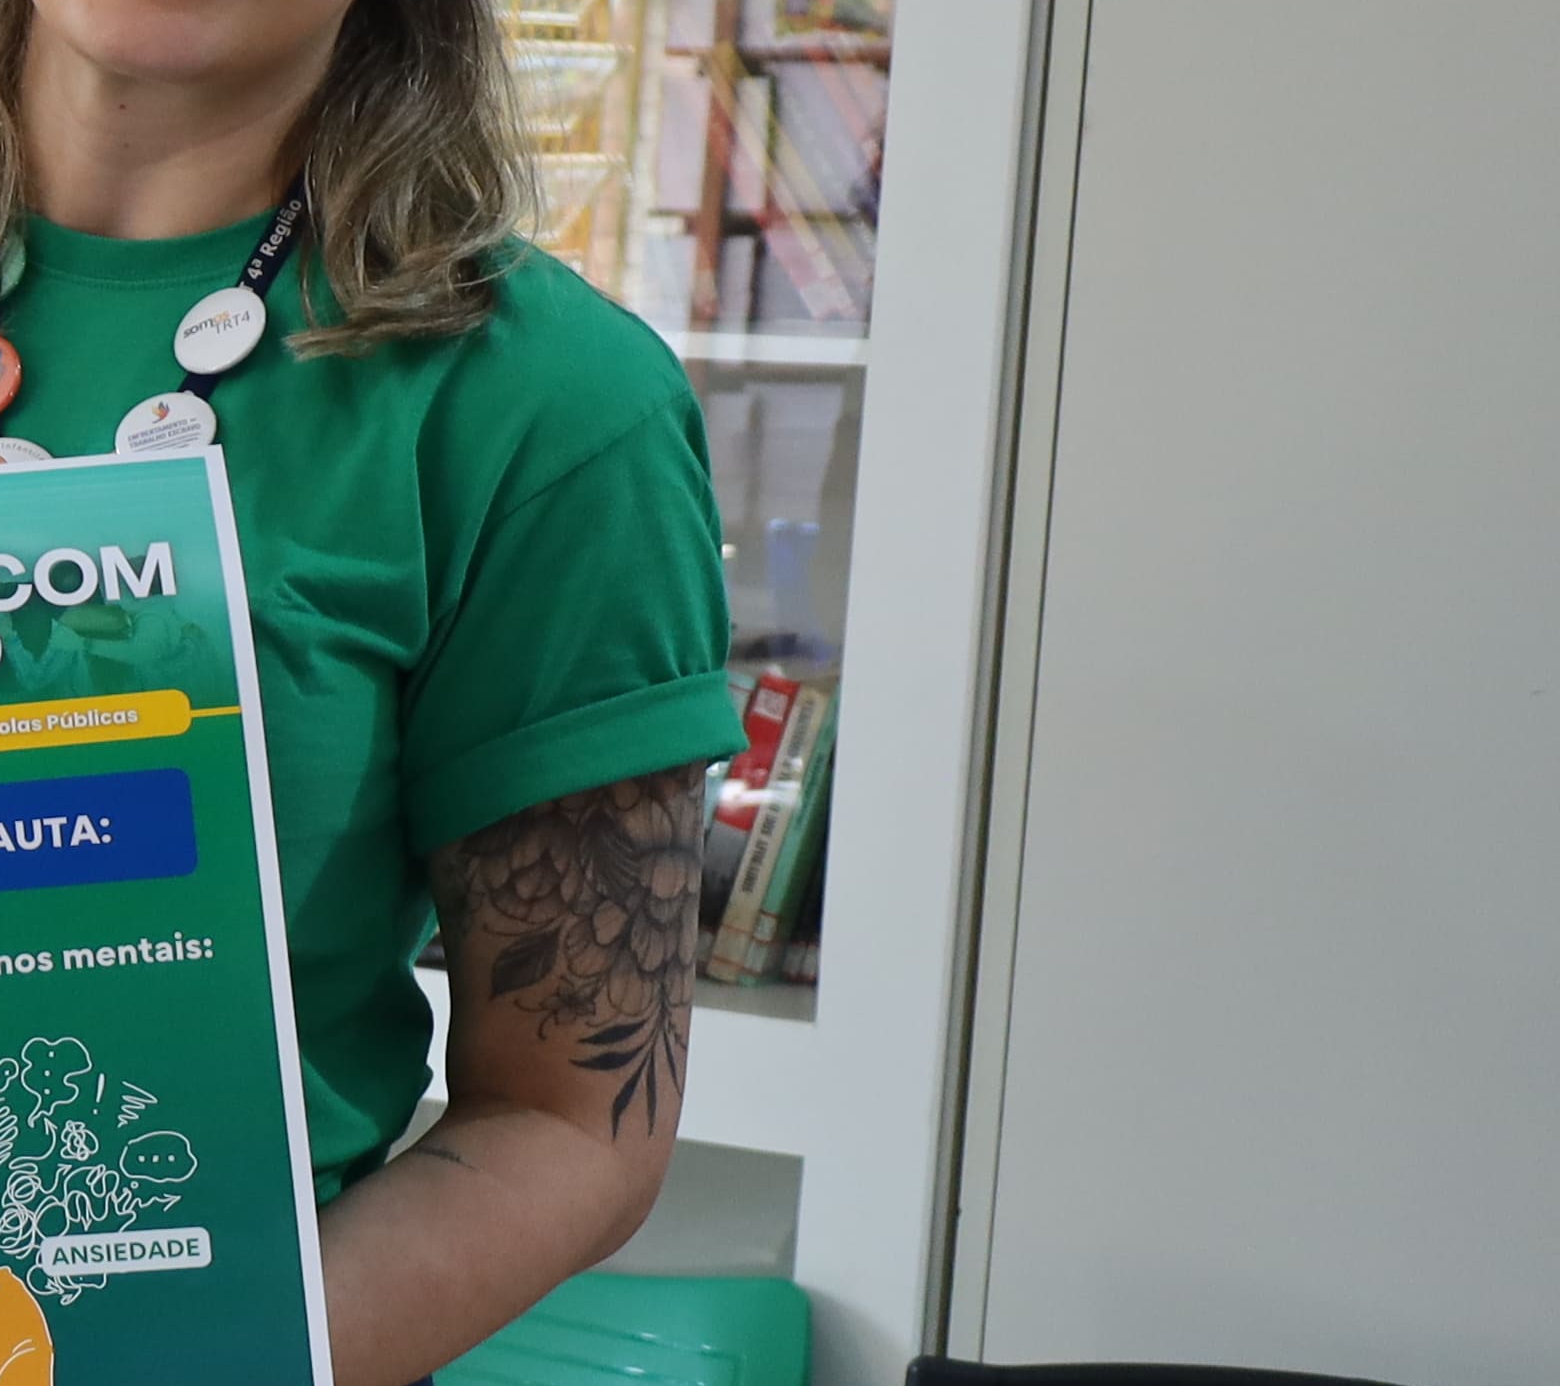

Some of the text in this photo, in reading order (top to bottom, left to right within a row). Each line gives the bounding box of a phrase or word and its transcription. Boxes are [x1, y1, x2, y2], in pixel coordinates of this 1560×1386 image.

[259, 199, 303, 257] Região
[62, 931, 214, 970] mentais:
[51, 1237, 201, 1267] ANSIEDADE
